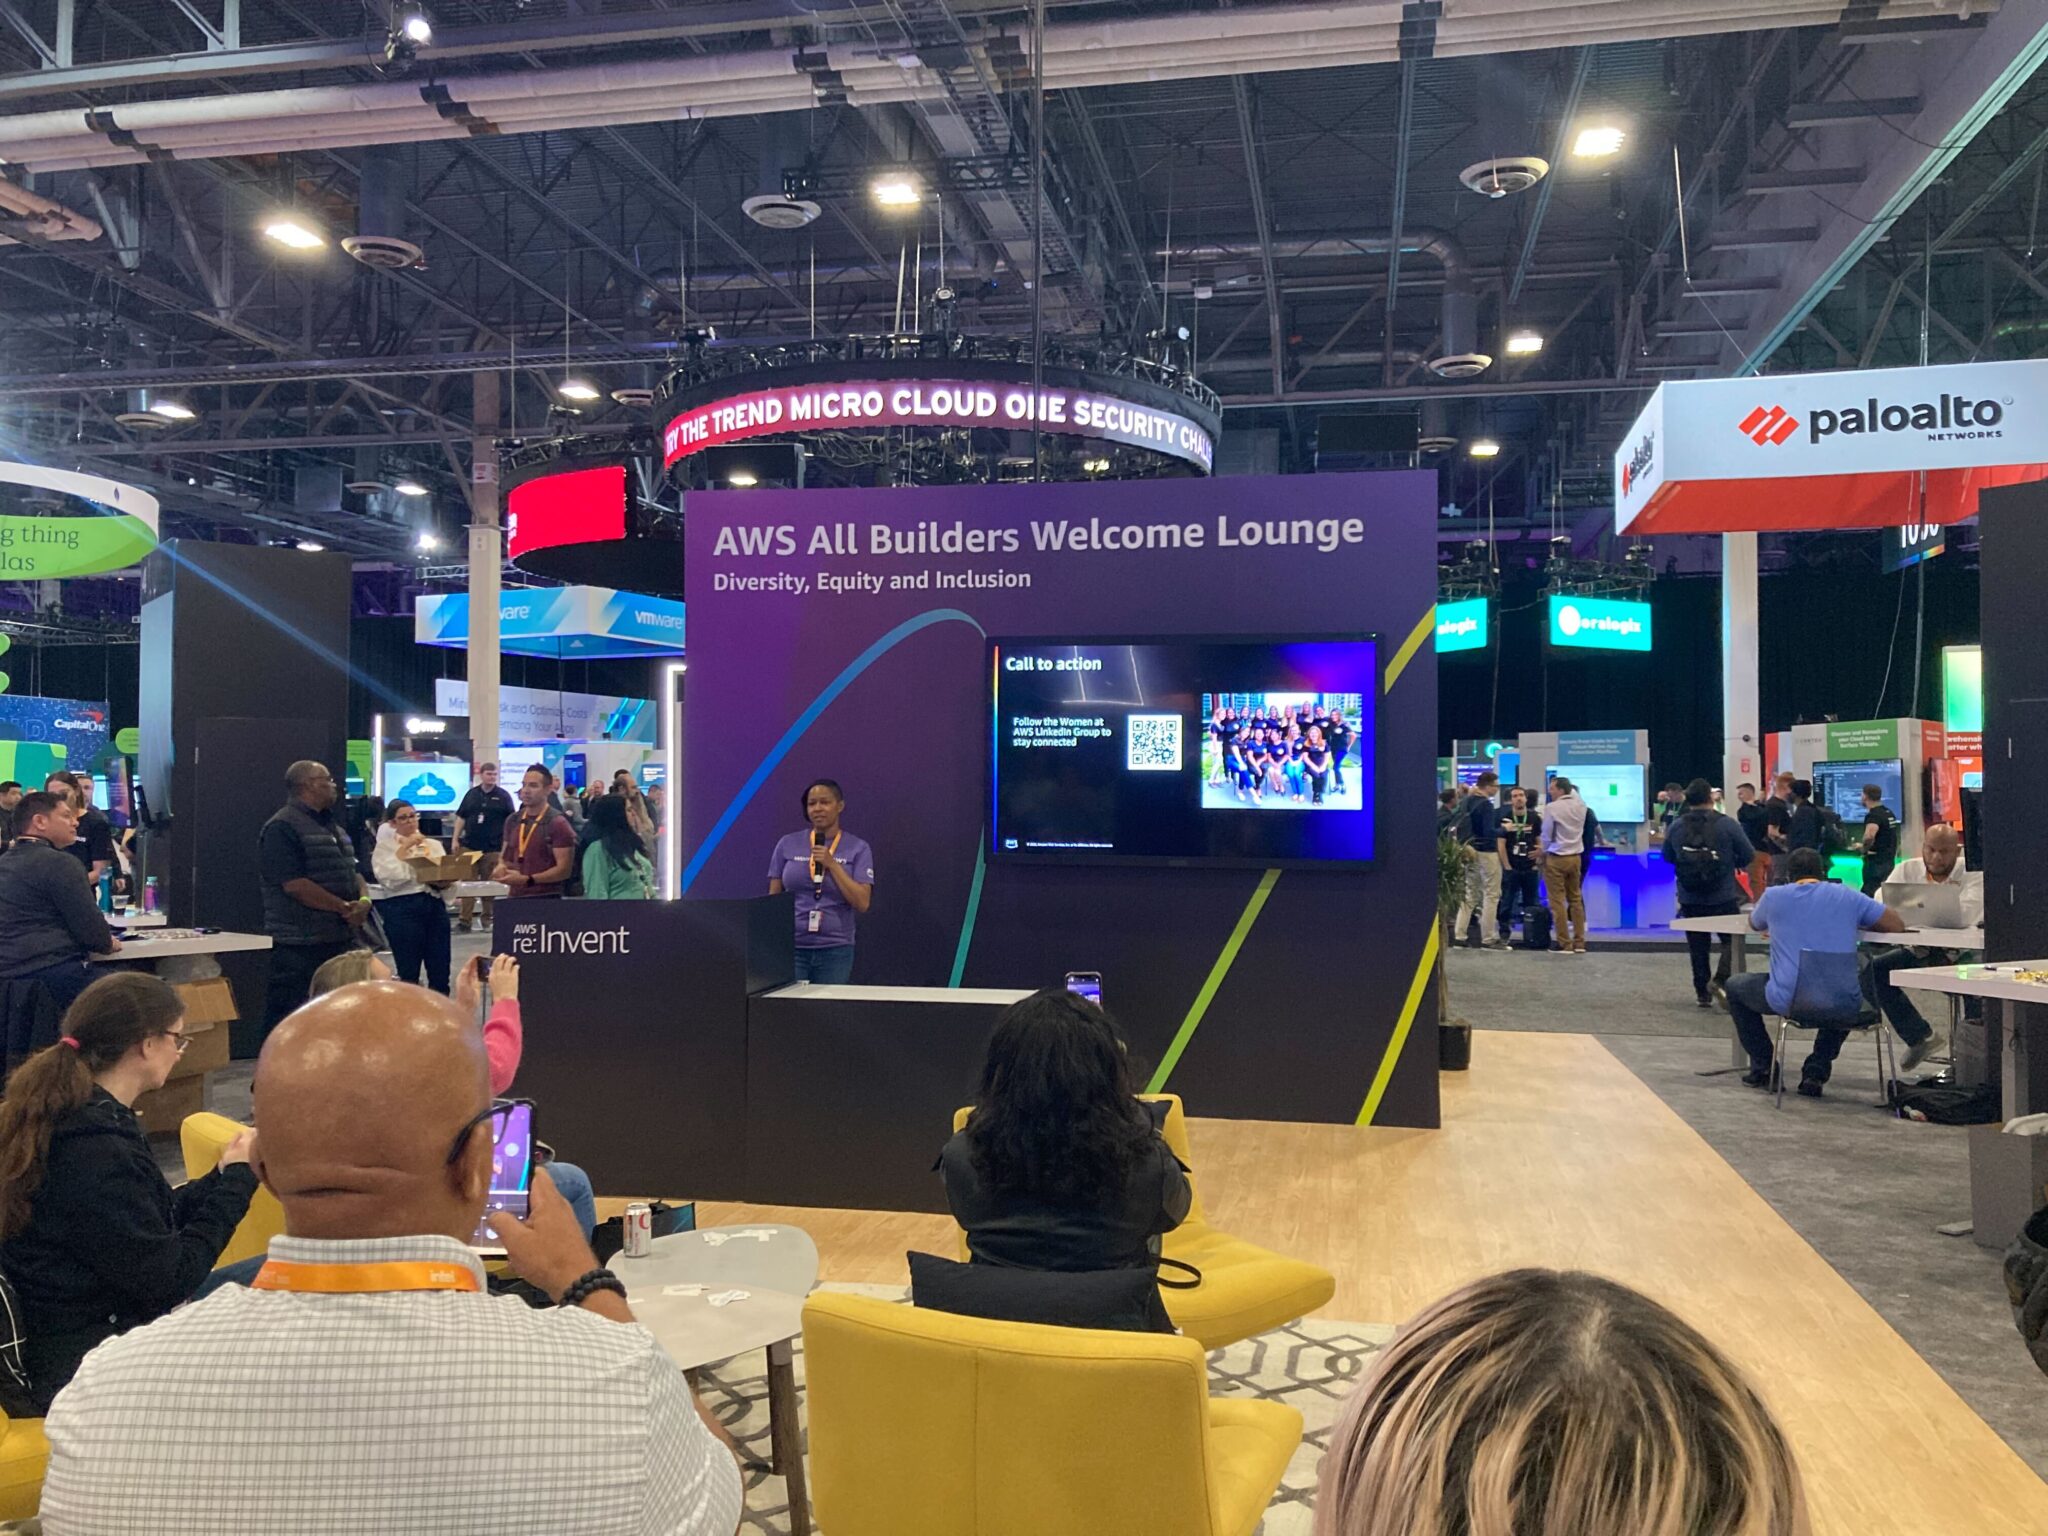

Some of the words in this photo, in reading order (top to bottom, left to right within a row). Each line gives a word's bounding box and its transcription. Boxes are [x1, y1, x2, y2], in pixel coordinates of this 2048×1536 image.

[665, 429, 680, 458] TRY
[681, 414, 709, 446] THE
[712, 398, 783, 434] TREND
[790, 388, 884, 421] MICRO
[892, 389, 997, 417] CLOUD
[1005, 393, 1067, 423] ONE
[1074, 399, 1177, 445] SECURITY
[1810, 393, 2004, 444] paloalto
[1928, 430, 2003, 441] NETWORKS
[22, 525, 80, 549] thing
[713, 526, 797, 556] AWS
[807, 523, 858, 555] All
[870, 521, 1020, 554] Builders
[1030, 518, 1205, 551] Welcome
[1218, 515, 1364, 552] Lounge
[713, 572, 811, 595] Diversity,
[817, 570, 884, 594] Equity
[890, 570, 929, 589] and
[936, 569, 1031, 589] Inclusion
[635, 610, 683, 629] vmware
[1006, 657, 1034, 671] Call
[1037, 658, 1053, 671] to
[1056, 657, 1102, 671] action
[1013, 717, 1042, 726] Follow
[1043, 717, 1058, 726] the
[1060, 718, 1093, 726] Women
[1094, 718, 1104, 726] at
[1013, 728, 1034, 736] AWS
[1073, 728, 1100, 738] Group
[1101, 728, 1112, 736] to
[1013, 739, 1031, 748] stay
[1033, 738, 1077, 746] connected
[513, 924, 537, 934] AWS
